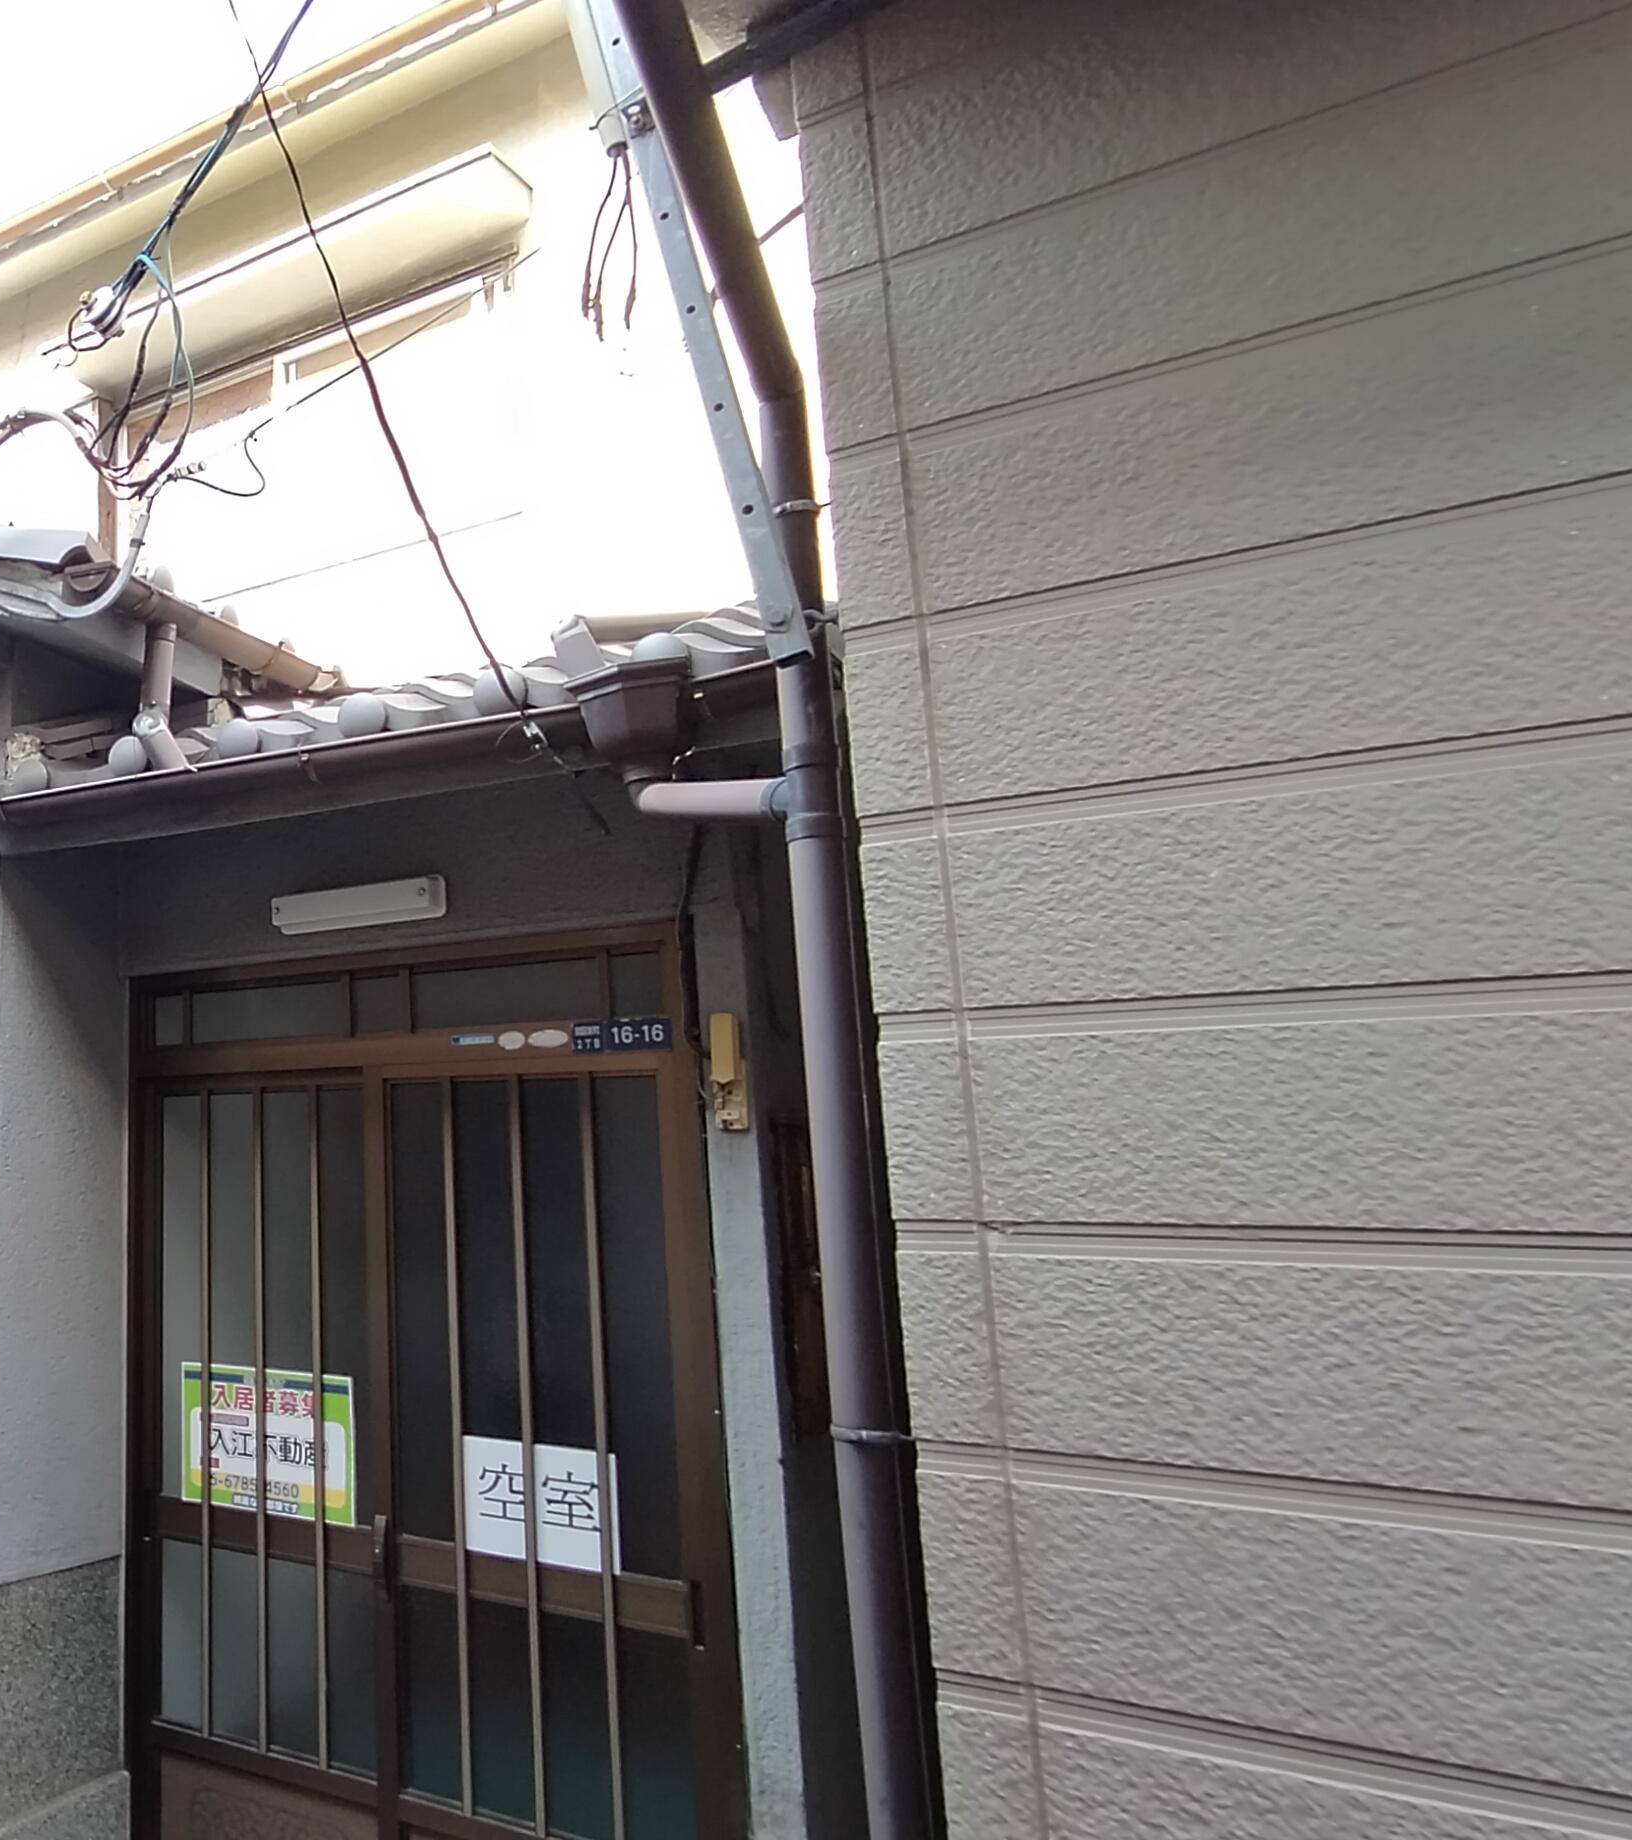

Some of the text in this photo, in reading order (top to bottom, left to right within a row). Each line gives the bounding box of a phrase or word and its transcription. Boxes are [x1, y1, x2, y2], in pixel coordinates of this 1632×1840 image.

[611, 1024, 664, 1044] 16-16
[208, 1473, 299, 1499] 6-67854560
[478, 1463, 602, 1532] 空室
